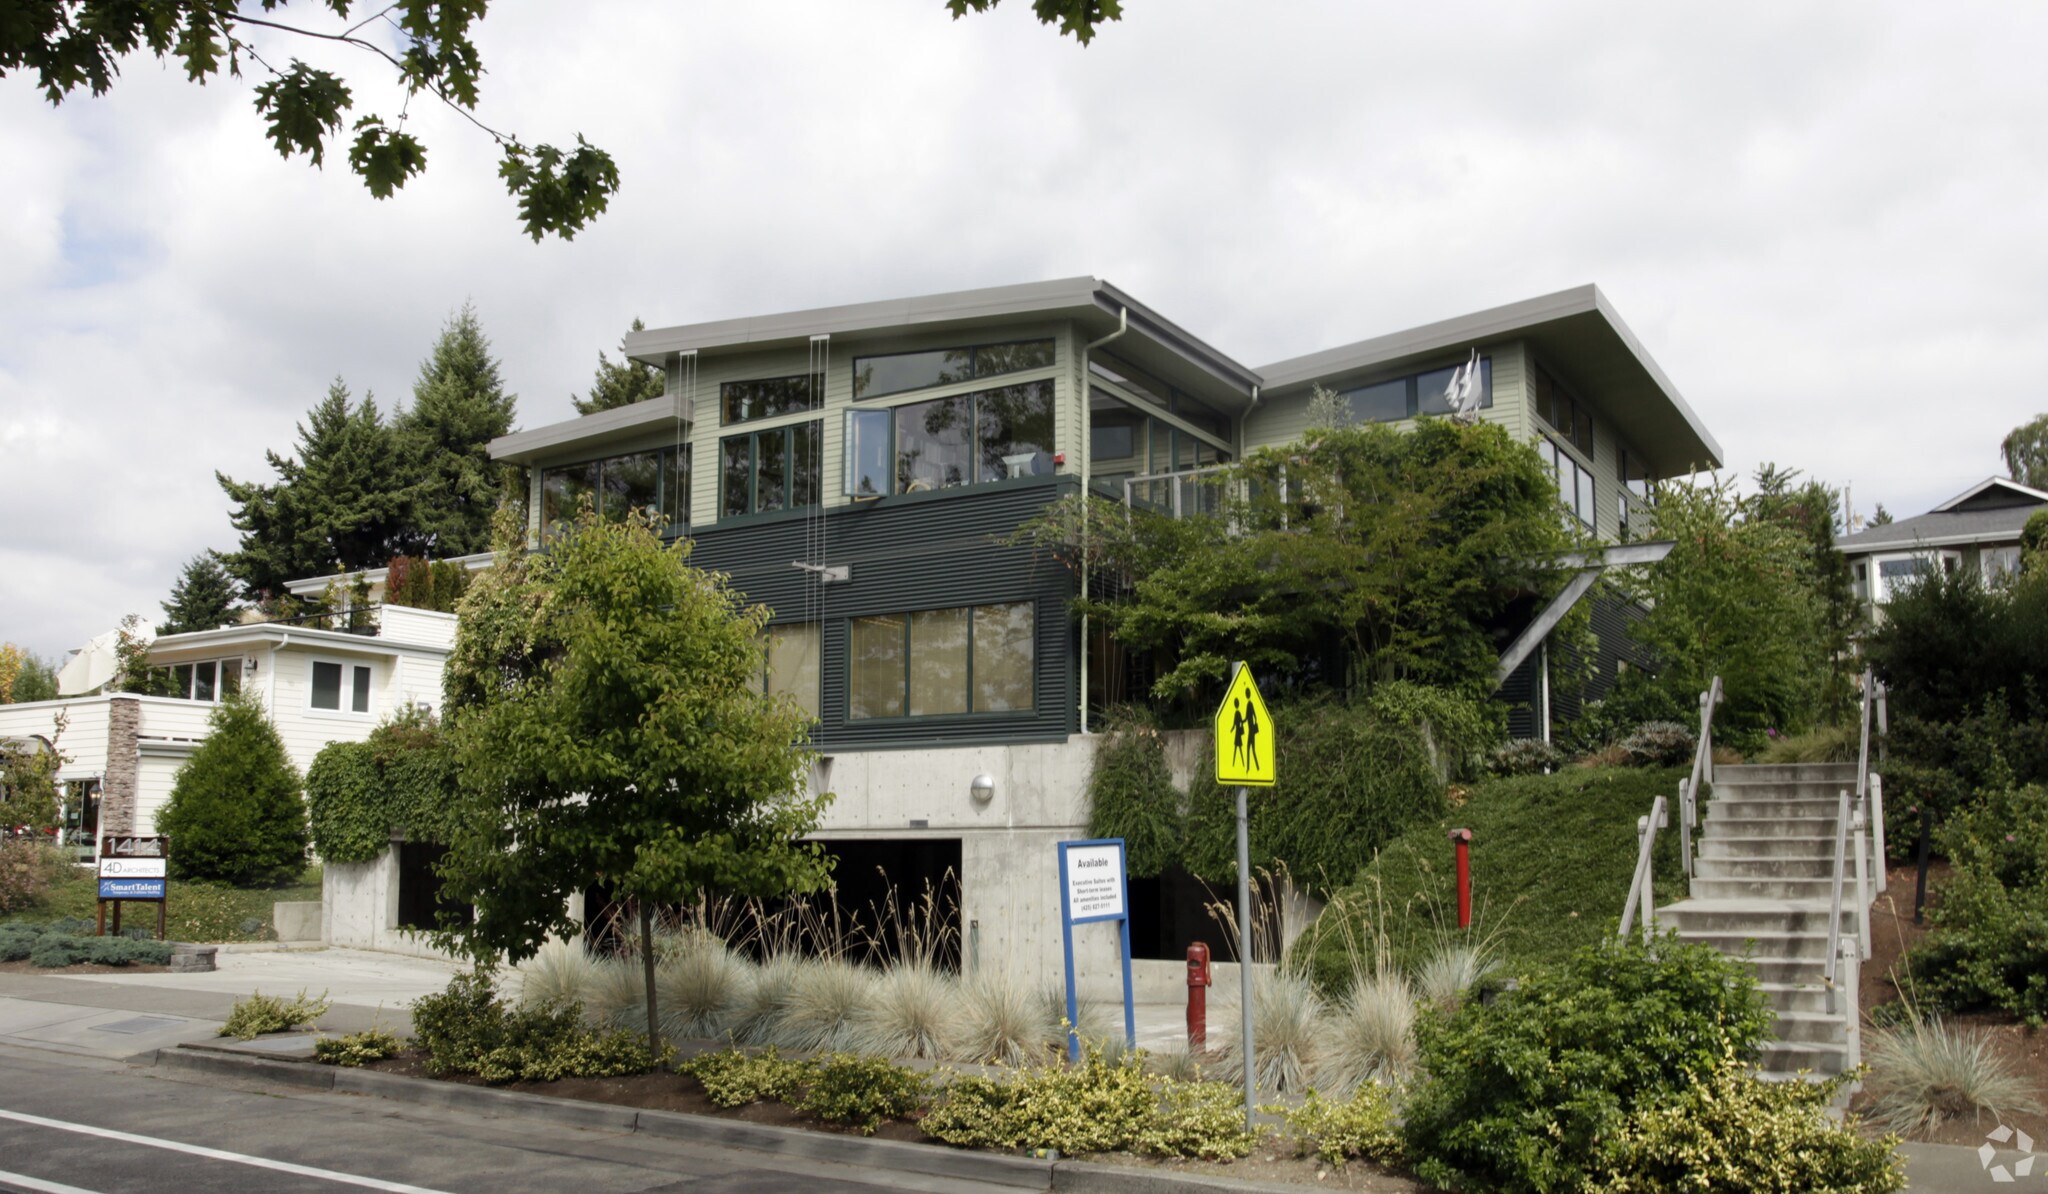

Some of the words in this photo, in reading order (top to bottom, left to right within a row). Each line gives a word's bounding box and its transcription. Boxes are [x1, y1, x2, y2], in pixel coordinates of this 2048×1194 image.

[104, 861, 122, 873] 4D
[1078, 858, 1108, 868] Available
[111, 883, 161, 891] SmartTalent
